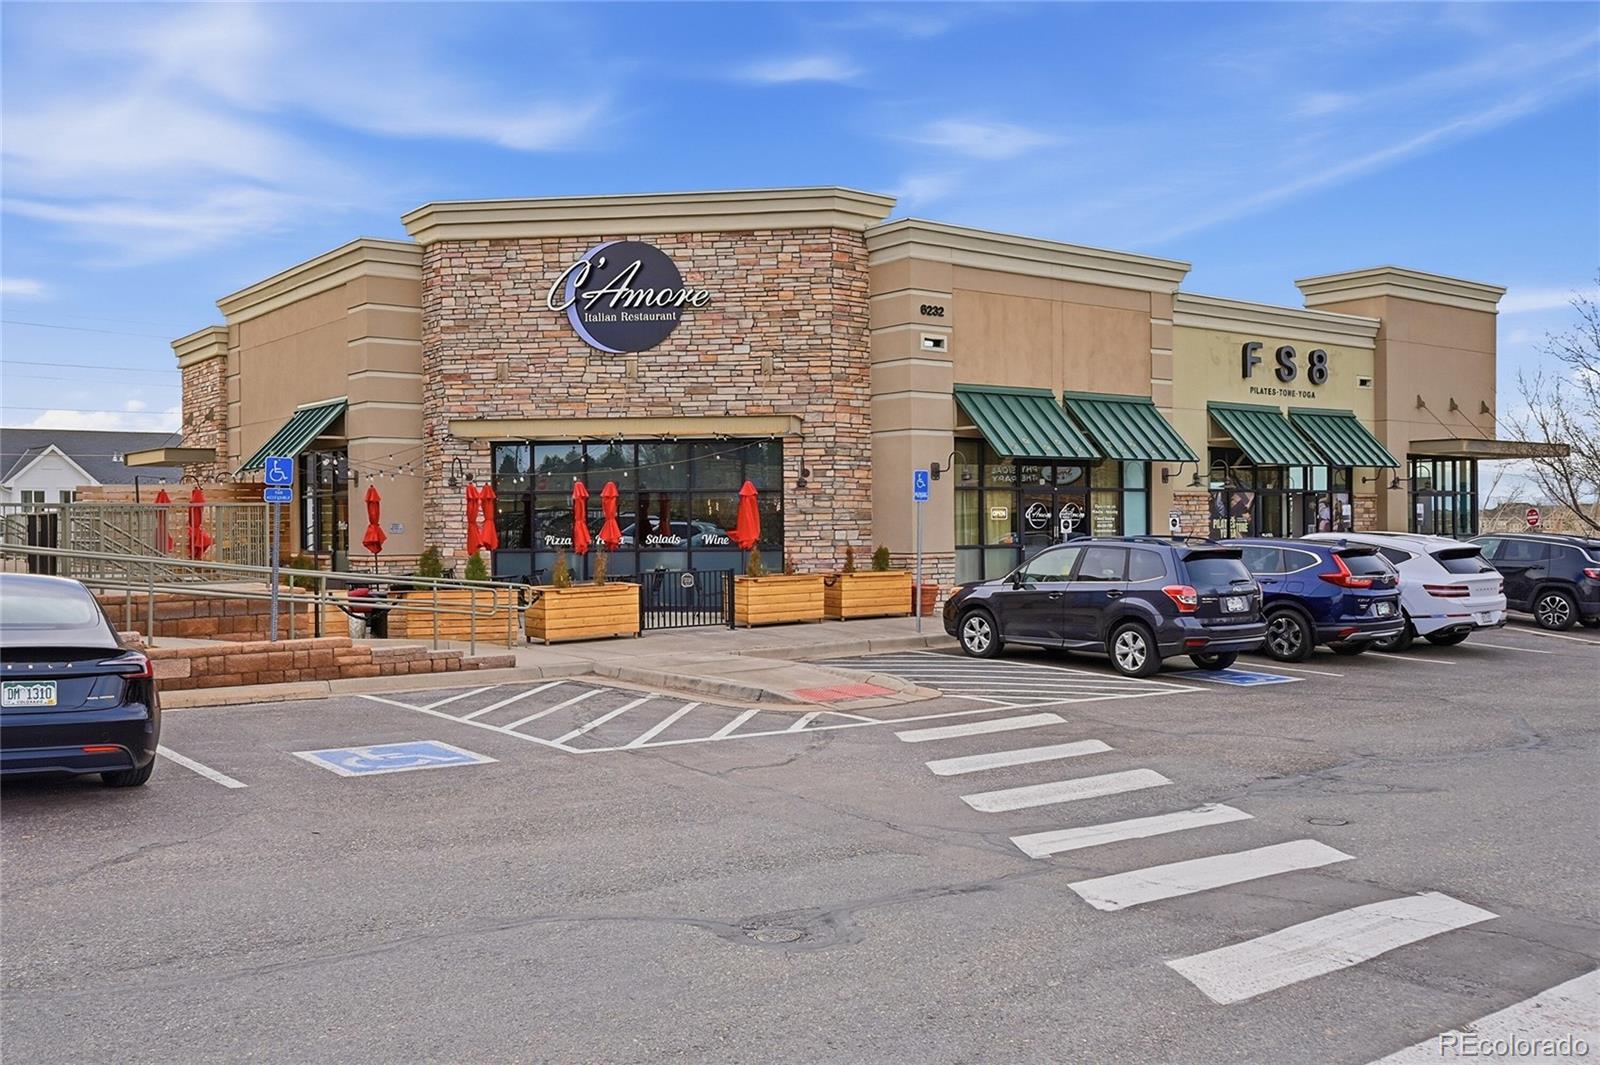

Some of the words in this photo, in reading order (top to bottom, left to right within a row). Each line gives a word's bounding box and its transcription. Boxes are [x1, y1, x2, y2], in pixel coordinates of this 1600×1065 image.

[547, 256, 711, 311] C'Amore
[584, 312, 617, 323] Italian
[620, 311, 677, 322] Restaurant
[920, 304, 944, 317] 6232
[544, 534, 573, 545] Pizza
[645, 534, 681, 546] Salads
[701, 534, 730, 546] Wine
[27, 687, 52, 700] 1310
